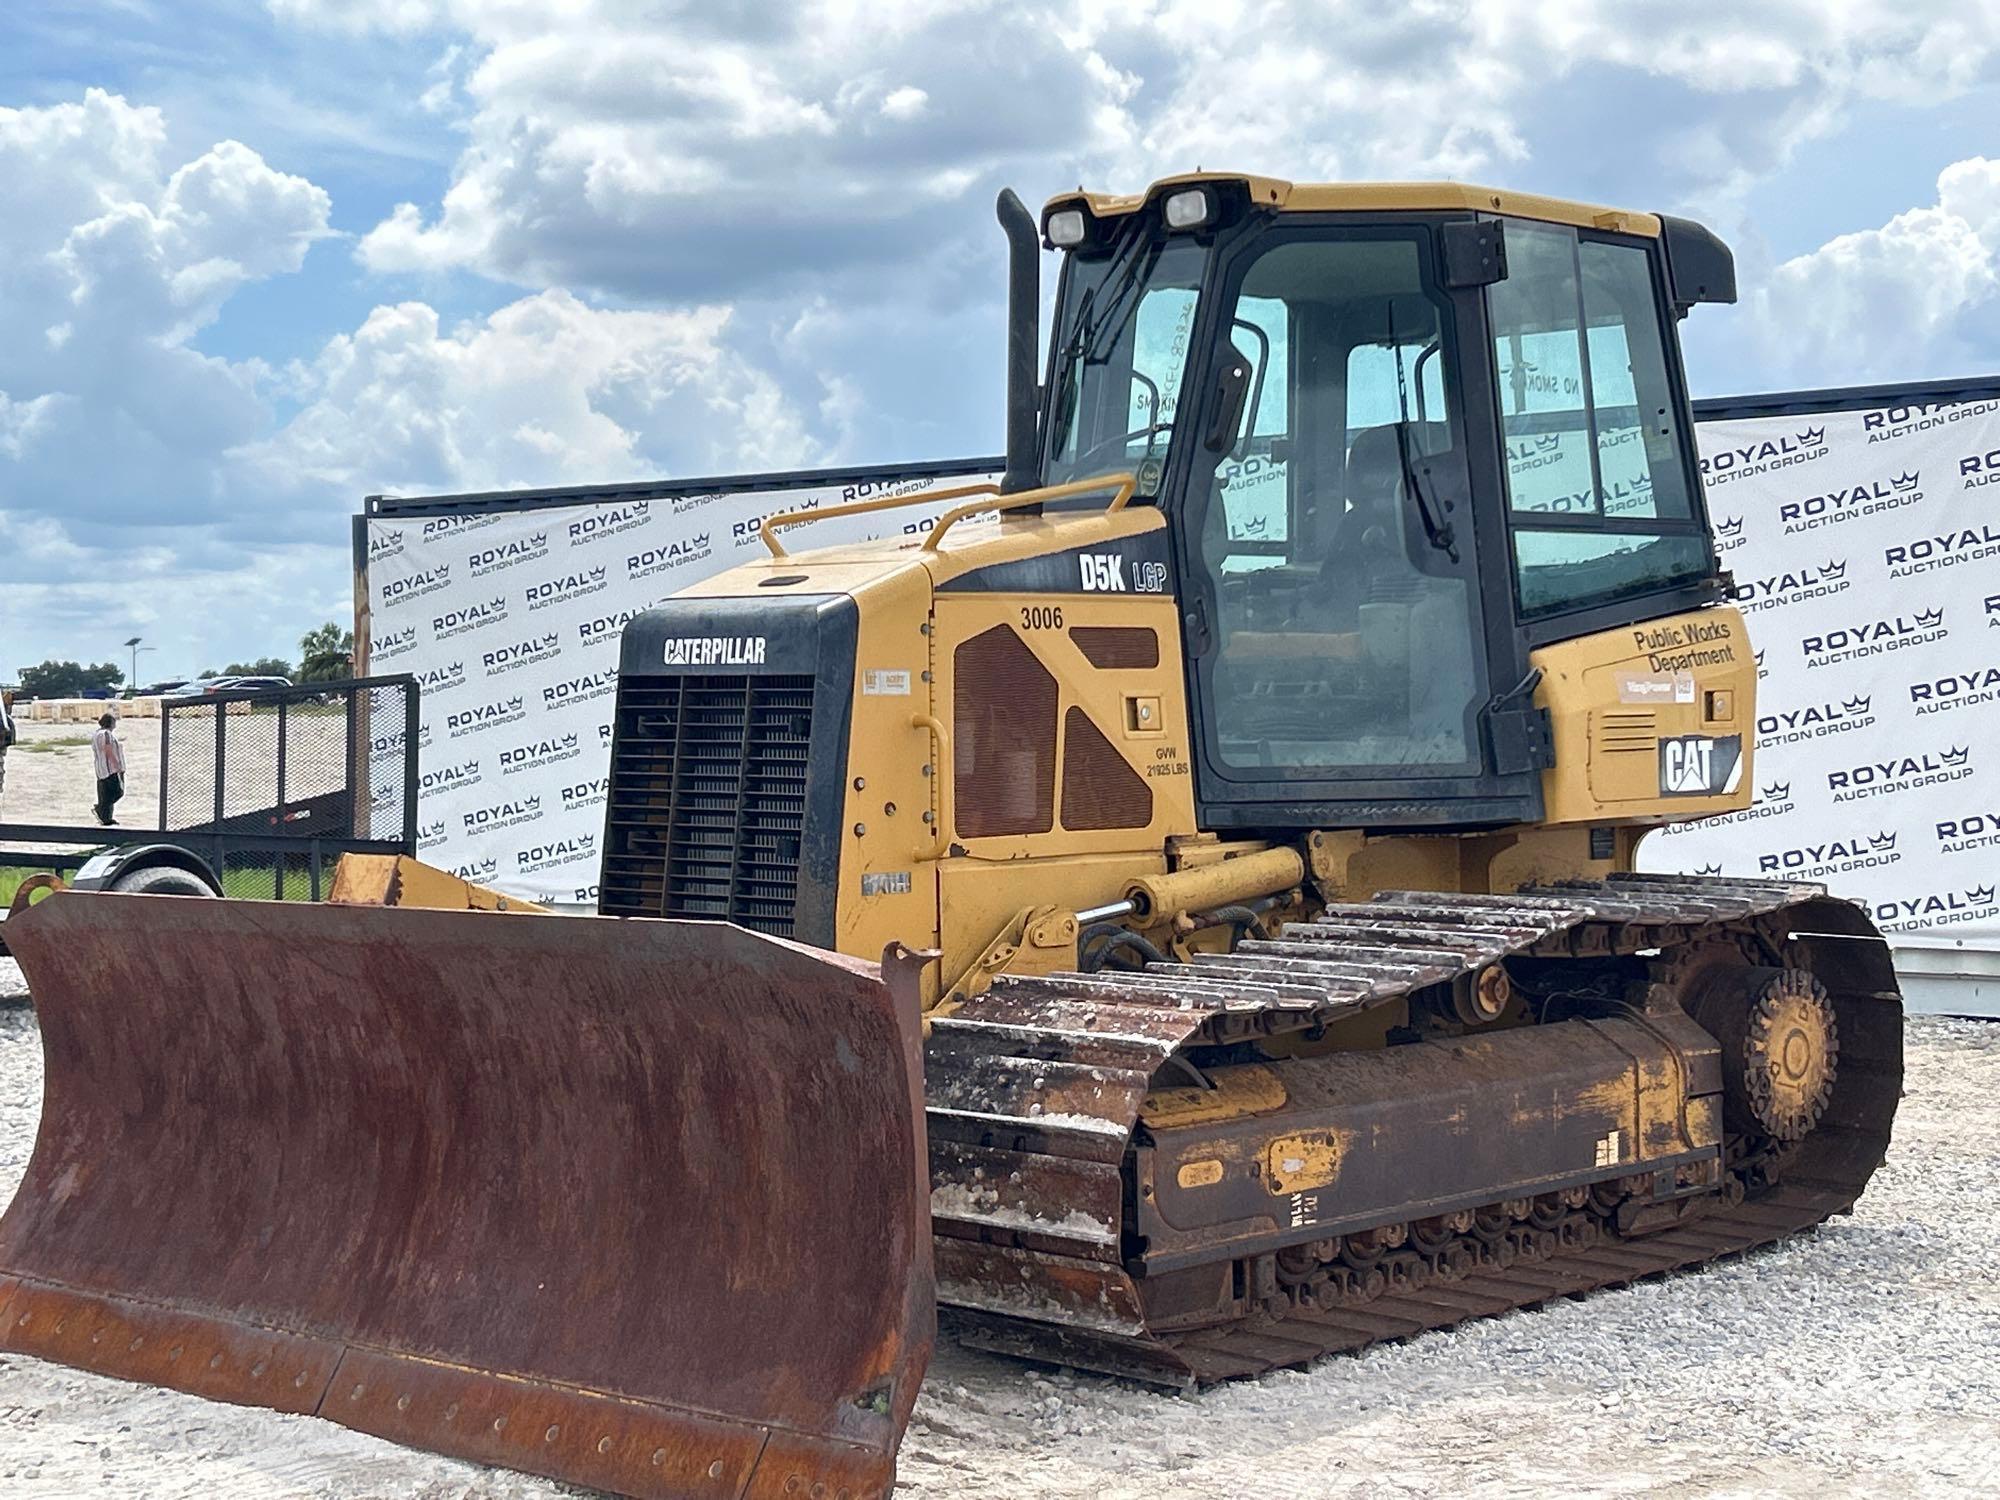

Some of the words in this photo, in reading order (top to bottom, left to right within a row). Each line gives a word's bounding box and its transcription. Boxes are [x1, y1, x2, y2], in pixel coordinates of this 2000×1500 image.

[1868, 415, 1945, 444] AUCTION
[1948, 401, 1998, 422] GROU
[1600, 430, 1638, 449] AUCT
[1511, 452, 1563, 474] GROUP
[1706, 463, 1768, 488] UCTION
[1771, 447, 1829, 470] GROUP
[896, 478, 934, 496] GROUP
[1780, 481, 1891, 522] ROYAL
[1784, 508, 1859, 536] AUCTION
[1862, 492, 1924, 516] GROUP
[423, 527, 466, 544] AUCTION
[468, 516, 501, 531] GROUP
[569, 508, 633, 538] ROYAL
[570, 528, 615, 547] AUCTION
[616, 516, 652, 533] GROUP
[469, 540, 530, 568] ROYAL
[471, 560, 513, 578] AUCTION
[514, 548, 549, 565] GROUP
[627, 540, 693, 571] ROYAL
[629, 560, 674, 581] AUCTION
[676, 549, 712, 566] GROUP
[1889, 552, 1969, 580] AUCTION
[383, 571, 435, 599] ROYAL
[1079, 554, 1126, 591] D5K
[1132, 562, 1167, 592] LGP
[385, 588, 420, 608] AUCTION
[421, 579, 451, 595] GROUP
[526, 573, 589, 602] ROYAL
[529, 593, 572, 612] AUCTION
[573, 581, 608, 598] GROUP
[1791, 581, 1850, 603] GROUP
[433, 604, 490, 631] ROYAL
[435, 622, 475, 641] AUCTION
[476, 612, 508, 628] GROUP
[1021, 607, 1063, 630] 3006
[390, 642, 418, 657] GROUP
[1634, 627, 1682, 651] Public
[1685, 621, 1730, 644] Works
[1803, 617, 1915, 656] ROYAL
[1807, 643, 1883, 669] AUCTION
[1886, 629, 1948, 651] GROUP
[483, 640, 544, 667] ROYAL
[486, 660, 528, 677] AUCTION
[529, 648, 562, 665] GROUP
[664, 637, 766, 665] CATERPILLAR
[1648, 644, 1735, 675] Department
[418, 668, 449, 686] YAL
[435, 677, 466, 692] GROUP
[543, 674, 604, 701] ROYAL
[1910, 668, 2000, 702] ROYA
[547, 692, 588, 711] AUCTION
[590, 685, 617, 699] GROU
[1915, 691, 1993, 716] AUCTION
[447, 702, 508, 730] ROYAL
[450, 721, 491, 739] AUCTION
[492, 711, 526, 727] GROUP
[1757, 704, 1843, 734] OYAL
[1815, 716, 1876, 737] GROUP
[499, 739, 562, 766] ROYAL
[503, 758, 546, 776] AUCTION
[547, 748, 581, 764] GROUP
[1156, 748, 1176, 760] GVW
[1666, 740, 1713, 792] CAT
[1172, 762, 1188, 775] LBS
[1828, 754, 1940, 790] ROYAL
[419, 785, 449, 800] UCTION
[451, 775, 482, 790] GROUP
[561, 778, 610, 801] ROYA
[1833, 780, 1909, 804] AUCTION
[1912, 767, 1974, 790] GROUP
[463, 801, 525, 827] ROYAL
[466, 820, 509, 837] AUCTION
[510, 811, 544, 826] GROUP
[1662, 814, 1733, 836] AUCTION
[1737, 803, 1795, 823] GROUP
[517, 840, 579, 865] ROYAL
[519, 858, 562, 875] AUCTION
[563, 849, 597, 865] GROUP
[1759, 839, 1869, 873] ROYAL
[1841, 853, 1901, 872] GROUP
[1876, 893, 1966, 921] OYAL
[1879, 918, 1932, 934] CTION
[1936, 907, 1999, 926] GROUP
